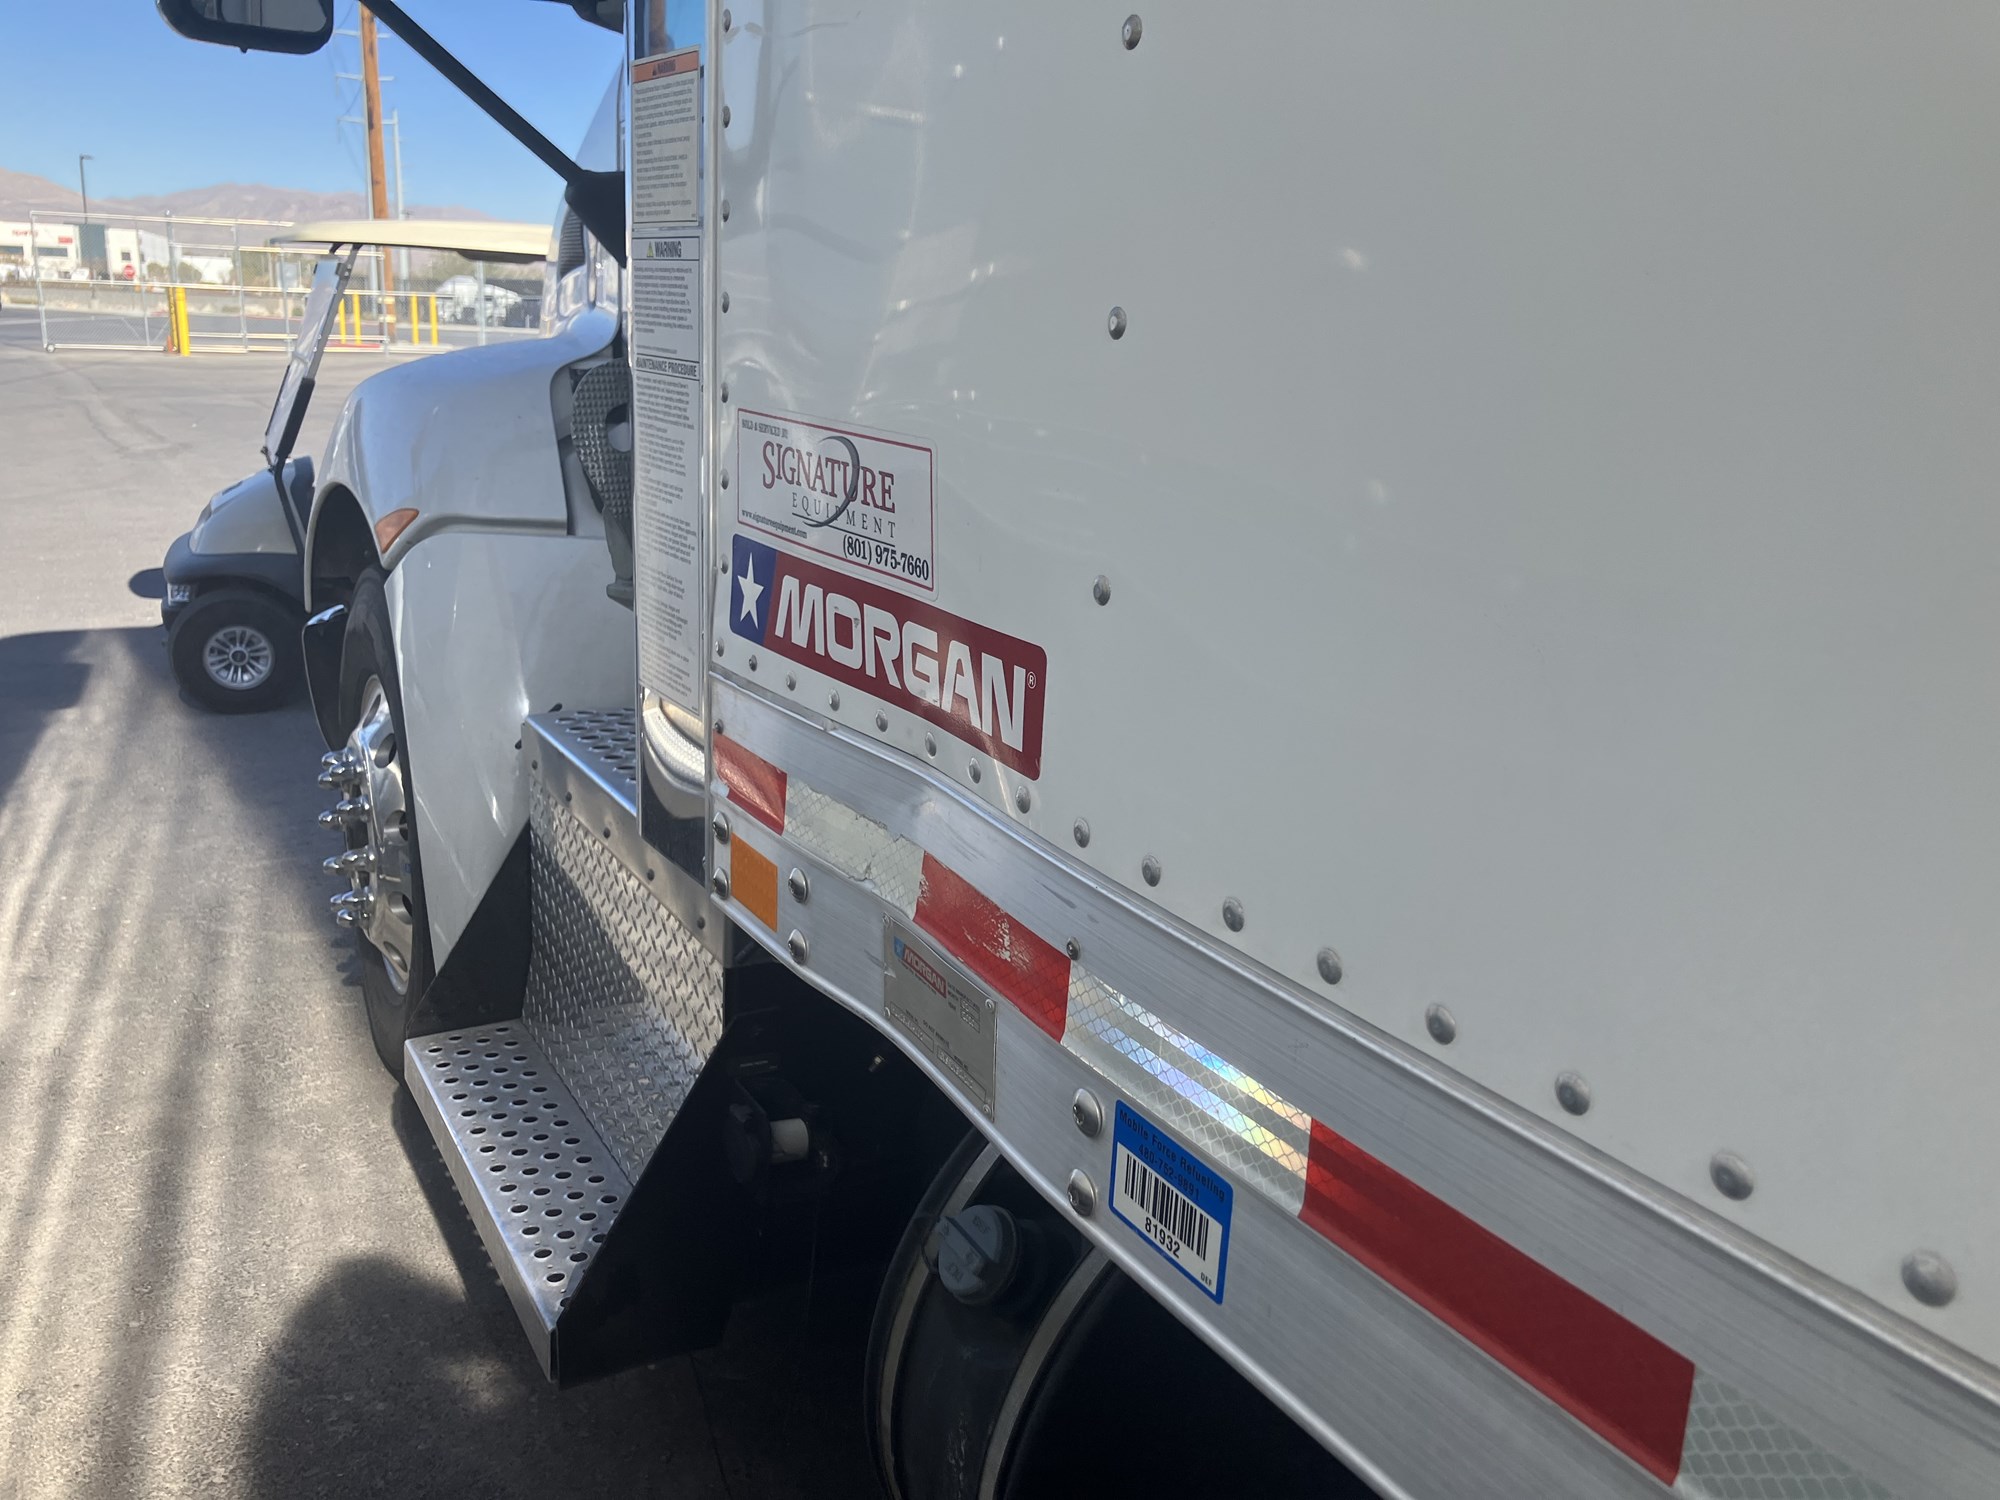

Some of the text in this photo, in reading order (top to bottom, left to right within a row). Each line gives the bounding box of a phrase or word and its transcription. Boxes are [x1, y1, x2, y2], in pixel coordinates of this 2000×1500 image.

[655, 241, 682, 258] WARNING
[636, 356, 697, 377] MAINTENANCE PROCEDURE
[762, 440, 896, 514] SIGNATURE
[742, 509, 808, 539] www.signatureequipment.com
[792, 492, 896, 538] EQUIPMENT
[843, 534, 929, 581] (801) 975-7660
[904, 948, 945, 993] MORGAN
[1120, 1109, 1225, 1202] Mobile Force Refueling
[1144, 1217, 1180, 1259] 81932
